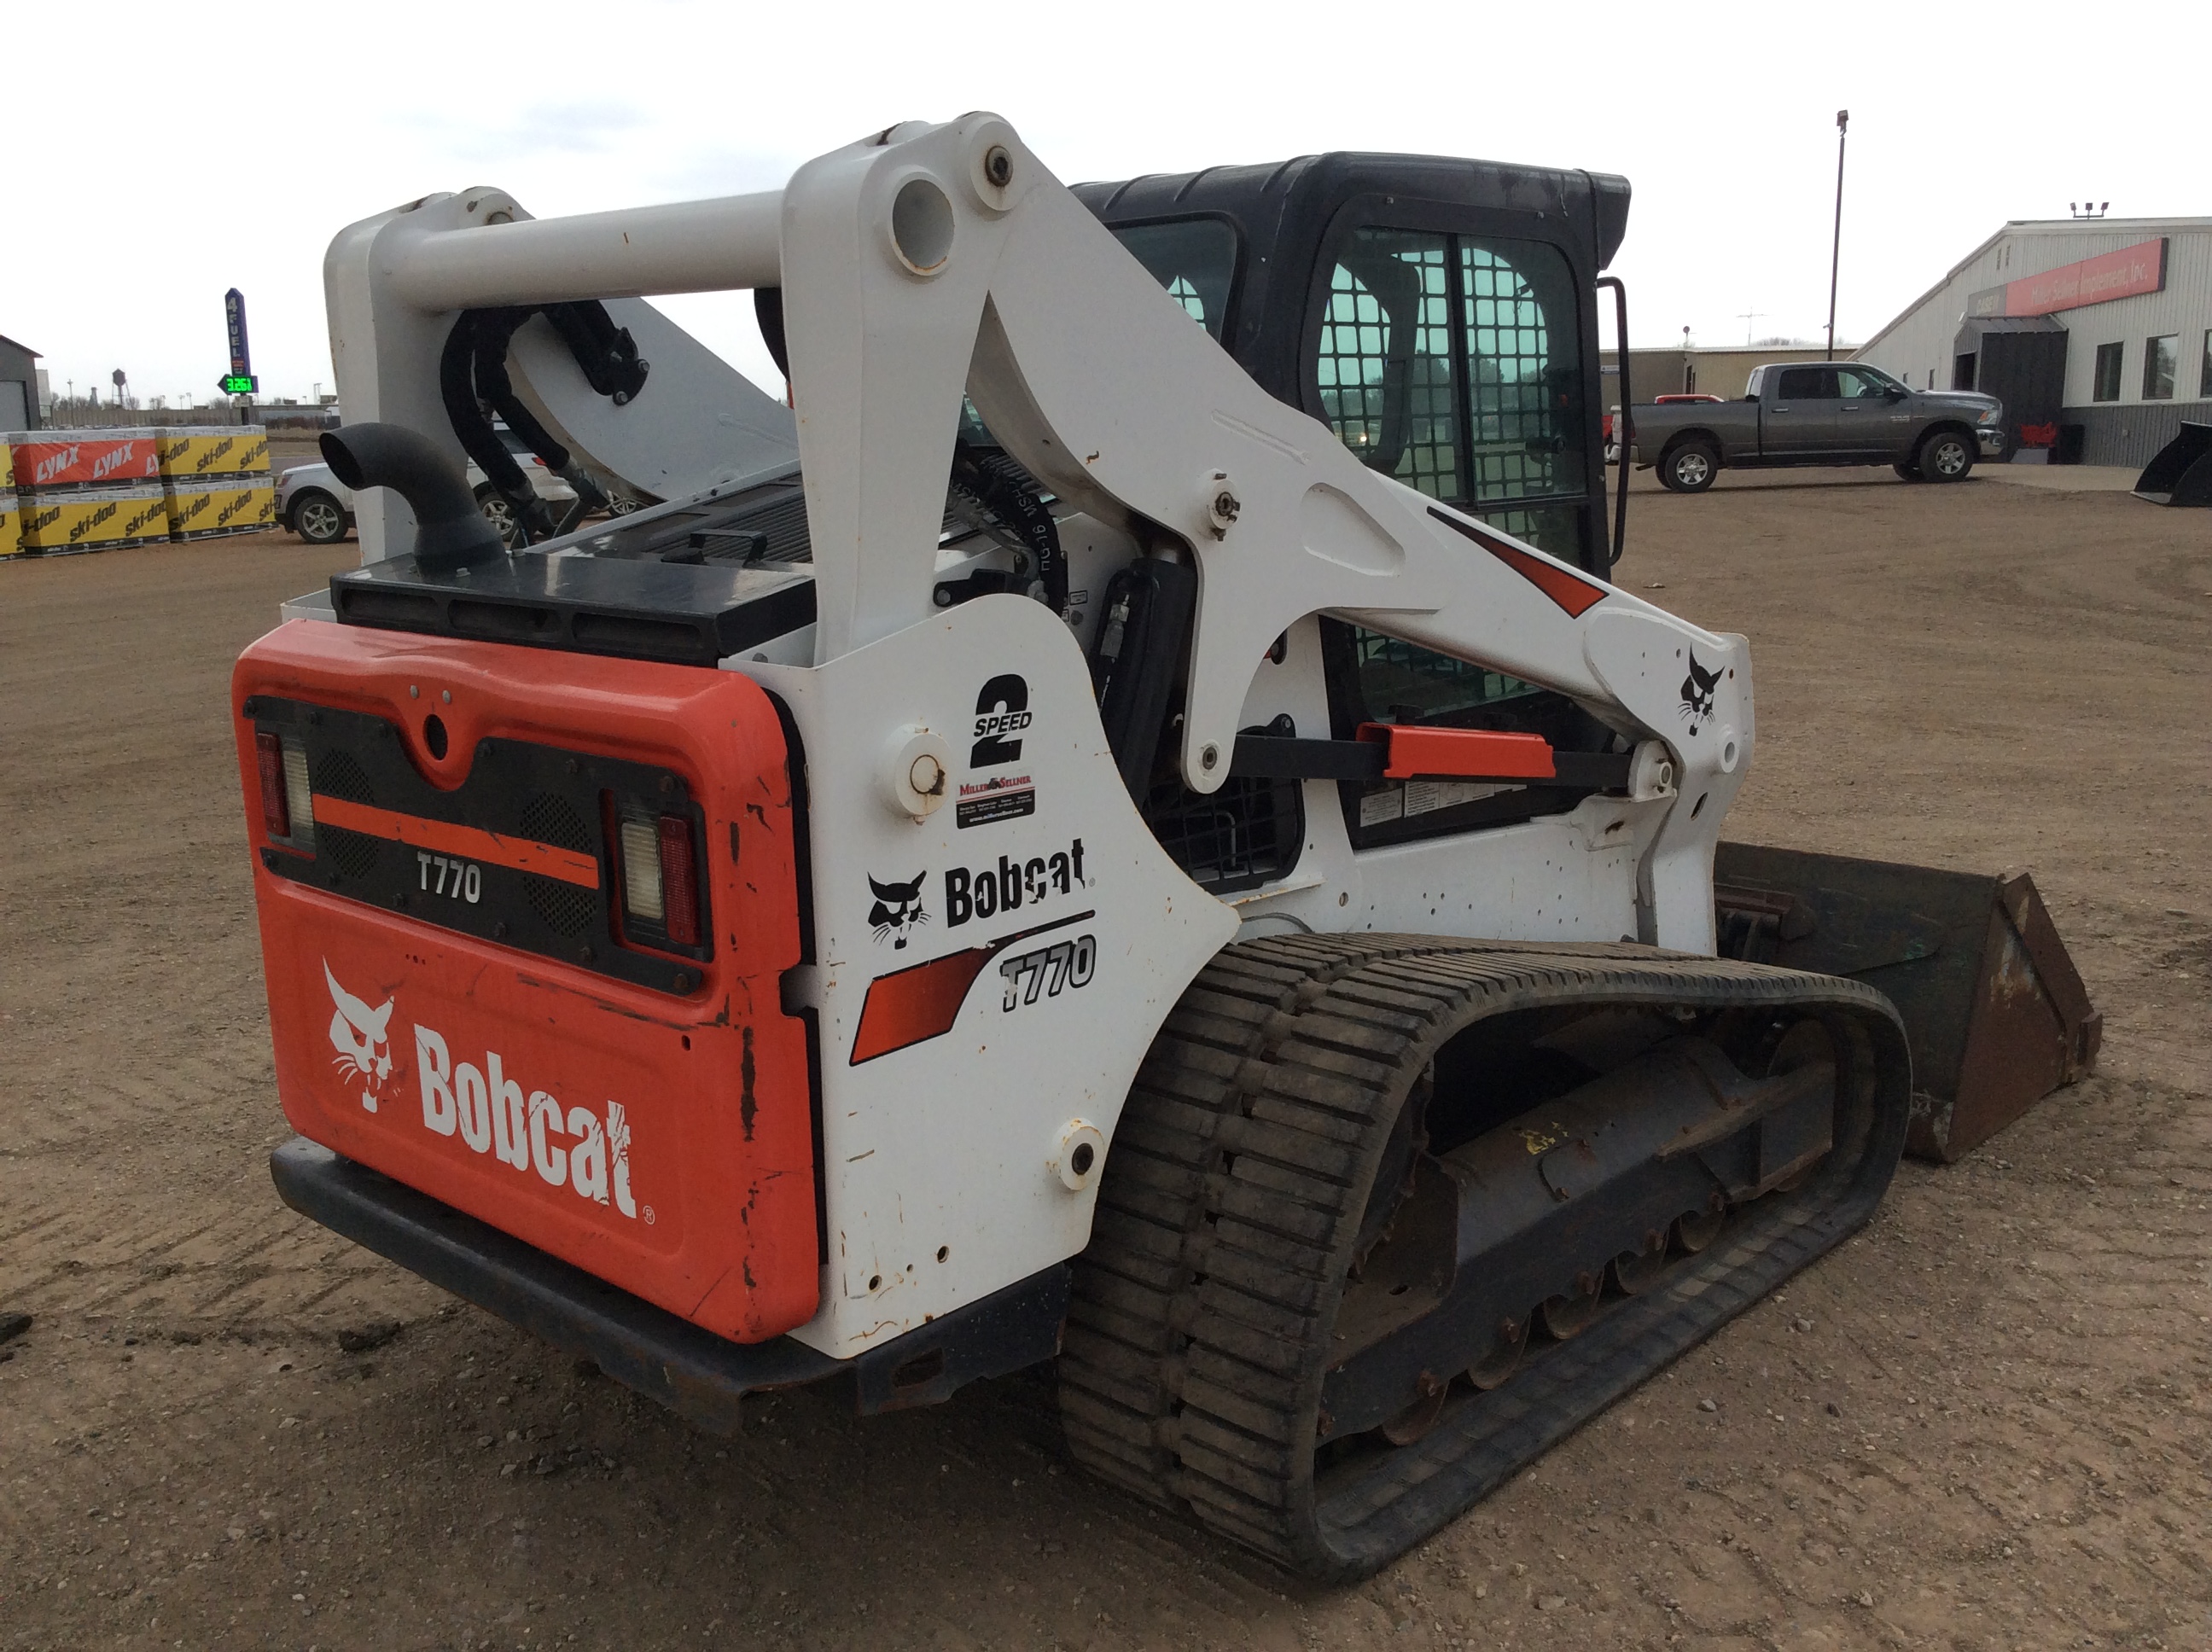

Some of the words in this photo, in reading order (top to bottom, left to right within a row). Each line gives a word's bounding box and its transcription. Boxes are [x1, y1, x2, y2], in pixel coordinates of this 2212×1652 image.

[2130, 259, 2148, 283] Inc.
[229, 313, 241, 358] FUEL
[37, 443, 80, 484] LYNX
[93, 440, 134, 480] LYNX
[196, 437, 233, 472] ski-doo
[70, 502, 117, 543] ski-doo
[125, 500, 166, 537] ski-doo
[218, 489, 253, 526] ski-doo
[969, 673, 1028, 769] 2
[973, 711, 1033, 737] SPEED
[416, 850, 481, 904] T770
[945, 837, 1086, 928] Bobcat
[998, 934, 1097, 1013] T770
[414, 1022, 637, 1219] Bobcat
